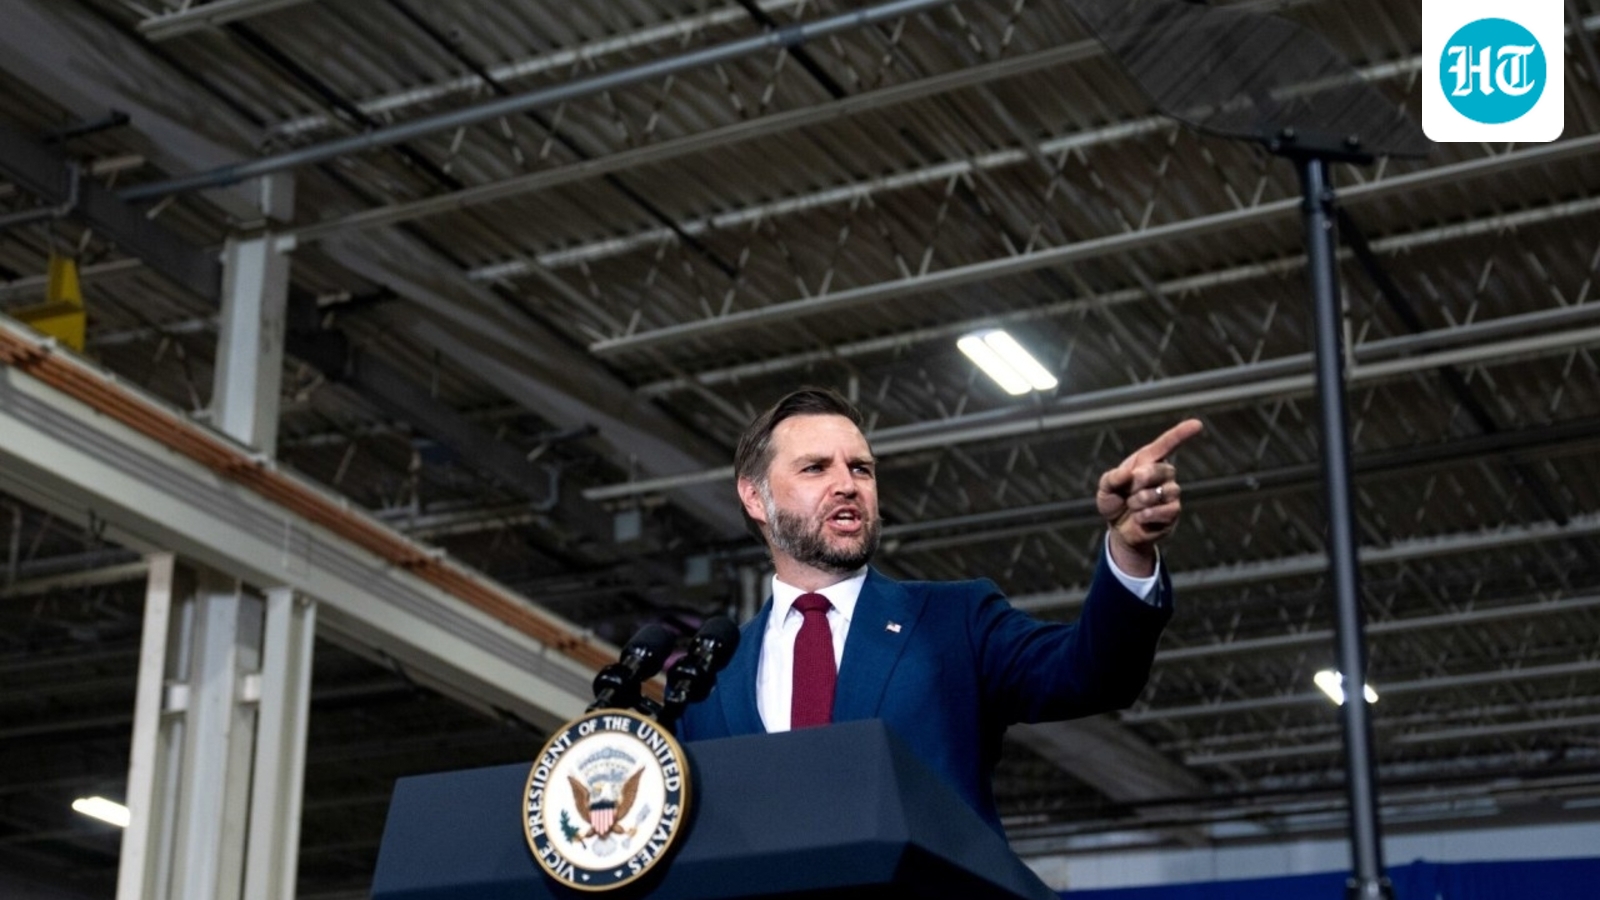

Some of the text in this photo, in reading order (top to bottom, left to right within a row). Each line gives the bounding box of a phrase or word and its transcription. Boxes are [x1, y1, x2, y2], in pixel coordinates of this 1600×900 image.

[528, 716, 680, 882] VICE PRESIDENT OF THE UNITED STATES
